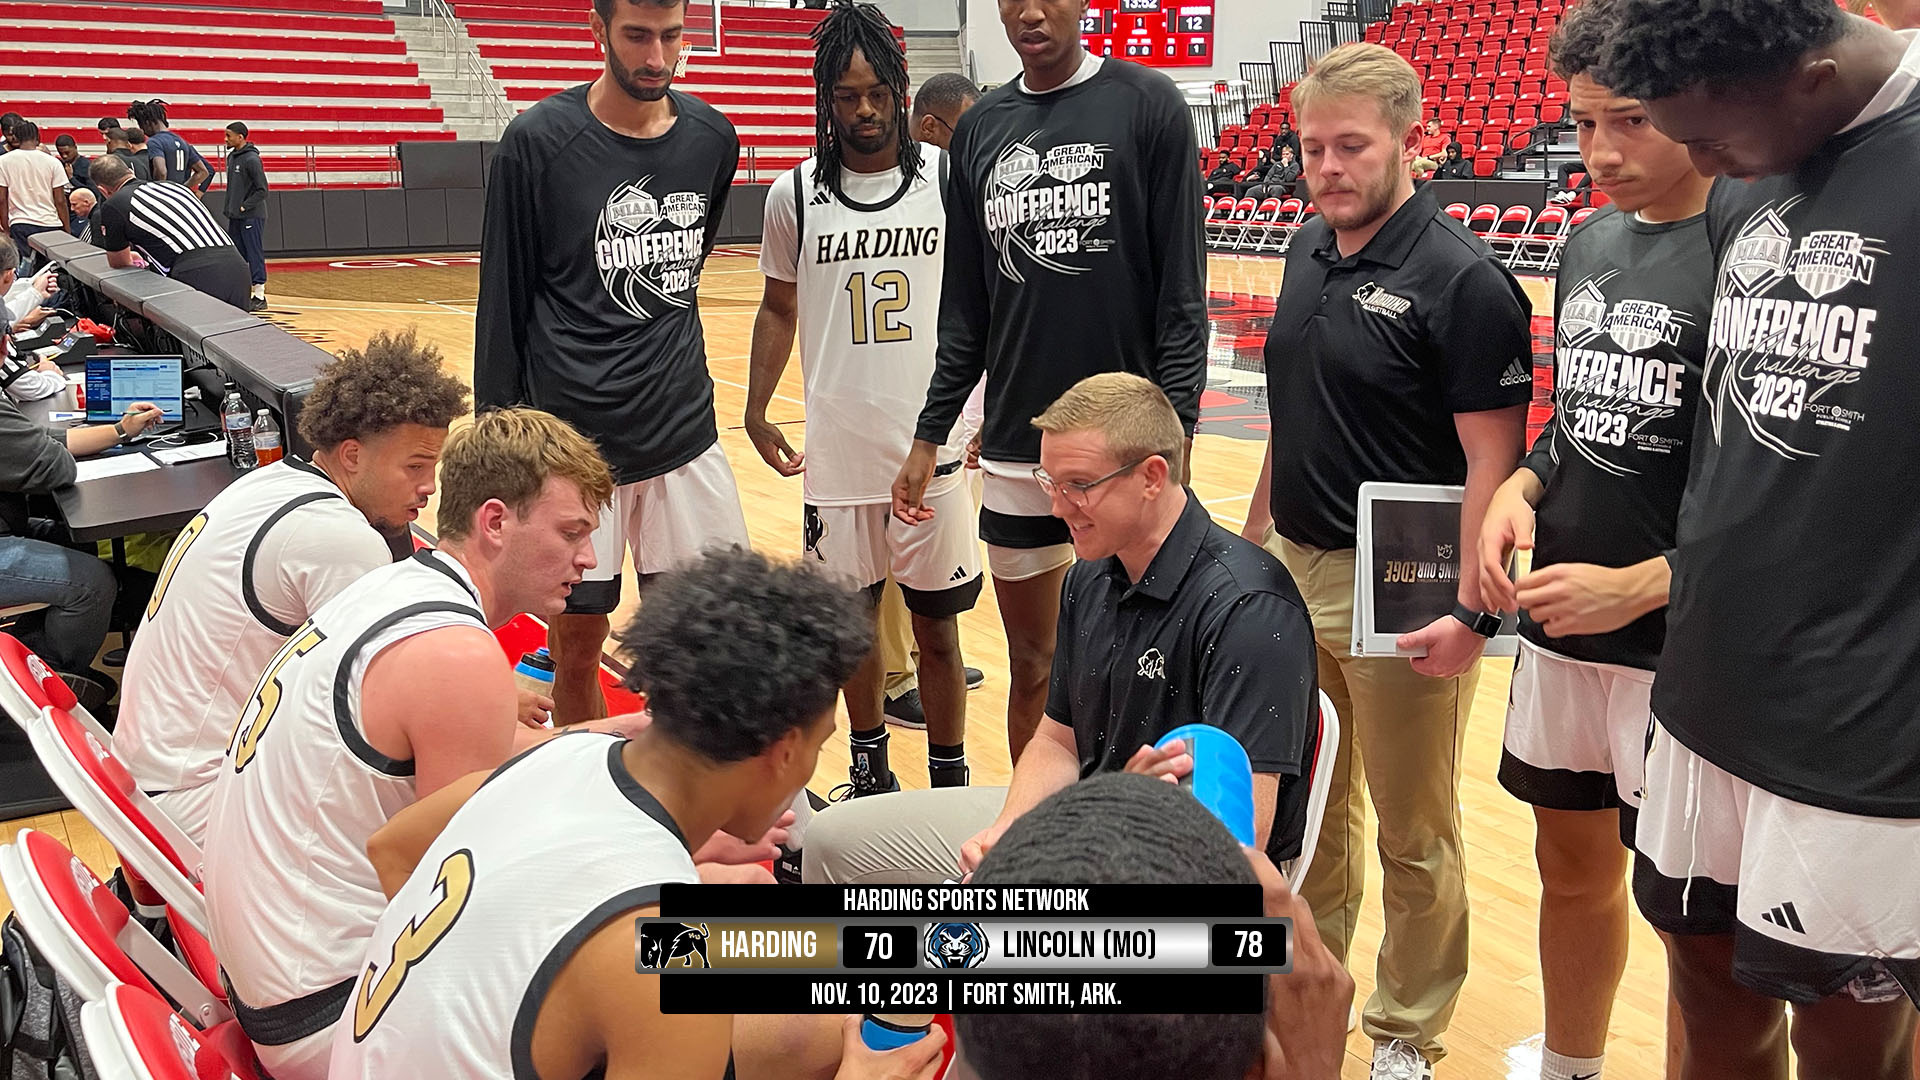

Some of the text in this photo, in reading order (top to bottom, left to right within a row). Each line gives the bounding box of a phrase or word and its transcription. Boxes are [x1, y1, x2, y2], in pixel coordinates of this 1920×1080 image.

[1185, 17, 1203, 30] 12
[1040, 154, 1104, 174] AMERICAN
[1053, 145, 1088, 157] GREAT
[660, 202, 706, 219] AMERICAN
[669, 194, 695, 203] GREAT
[985, 182, 1111, 231] CONFERENCE
[1025, 202, 1107, 240] Challenge
[816, 226, 939, 265] HARDING
[1035, 228, 1079, 255] 2023
[1809, 233, 1855, 250] GREAT
[1787, 250, 1874, 284] AMERICAN
[661, 269, 690, 294] 2023
[845, 269, 912, 345] 12
[1621, 303, 1663, 318] GREAT
[1603, 315, 1681, 346] AMERICAN
[1556, 347, 1685, 407] NFERENCE
[1738, 328, 1862, 403] Challenge
[1500, 374, 1532, 386] adidas
[1566, 374, 1675, 433] Challenge
[1750, 373, 1807, 421] 2023
[1804, 403, 1866, 422] FORT SMITH
[1573, 408, 1629, 447] 2023
[1627, 433, 1650, 442] FORT
[1384, 560, 1417, 583] EDGE
[1417, 562, 1437, 579] OUR
[353, 848, 475, 1044] 3
